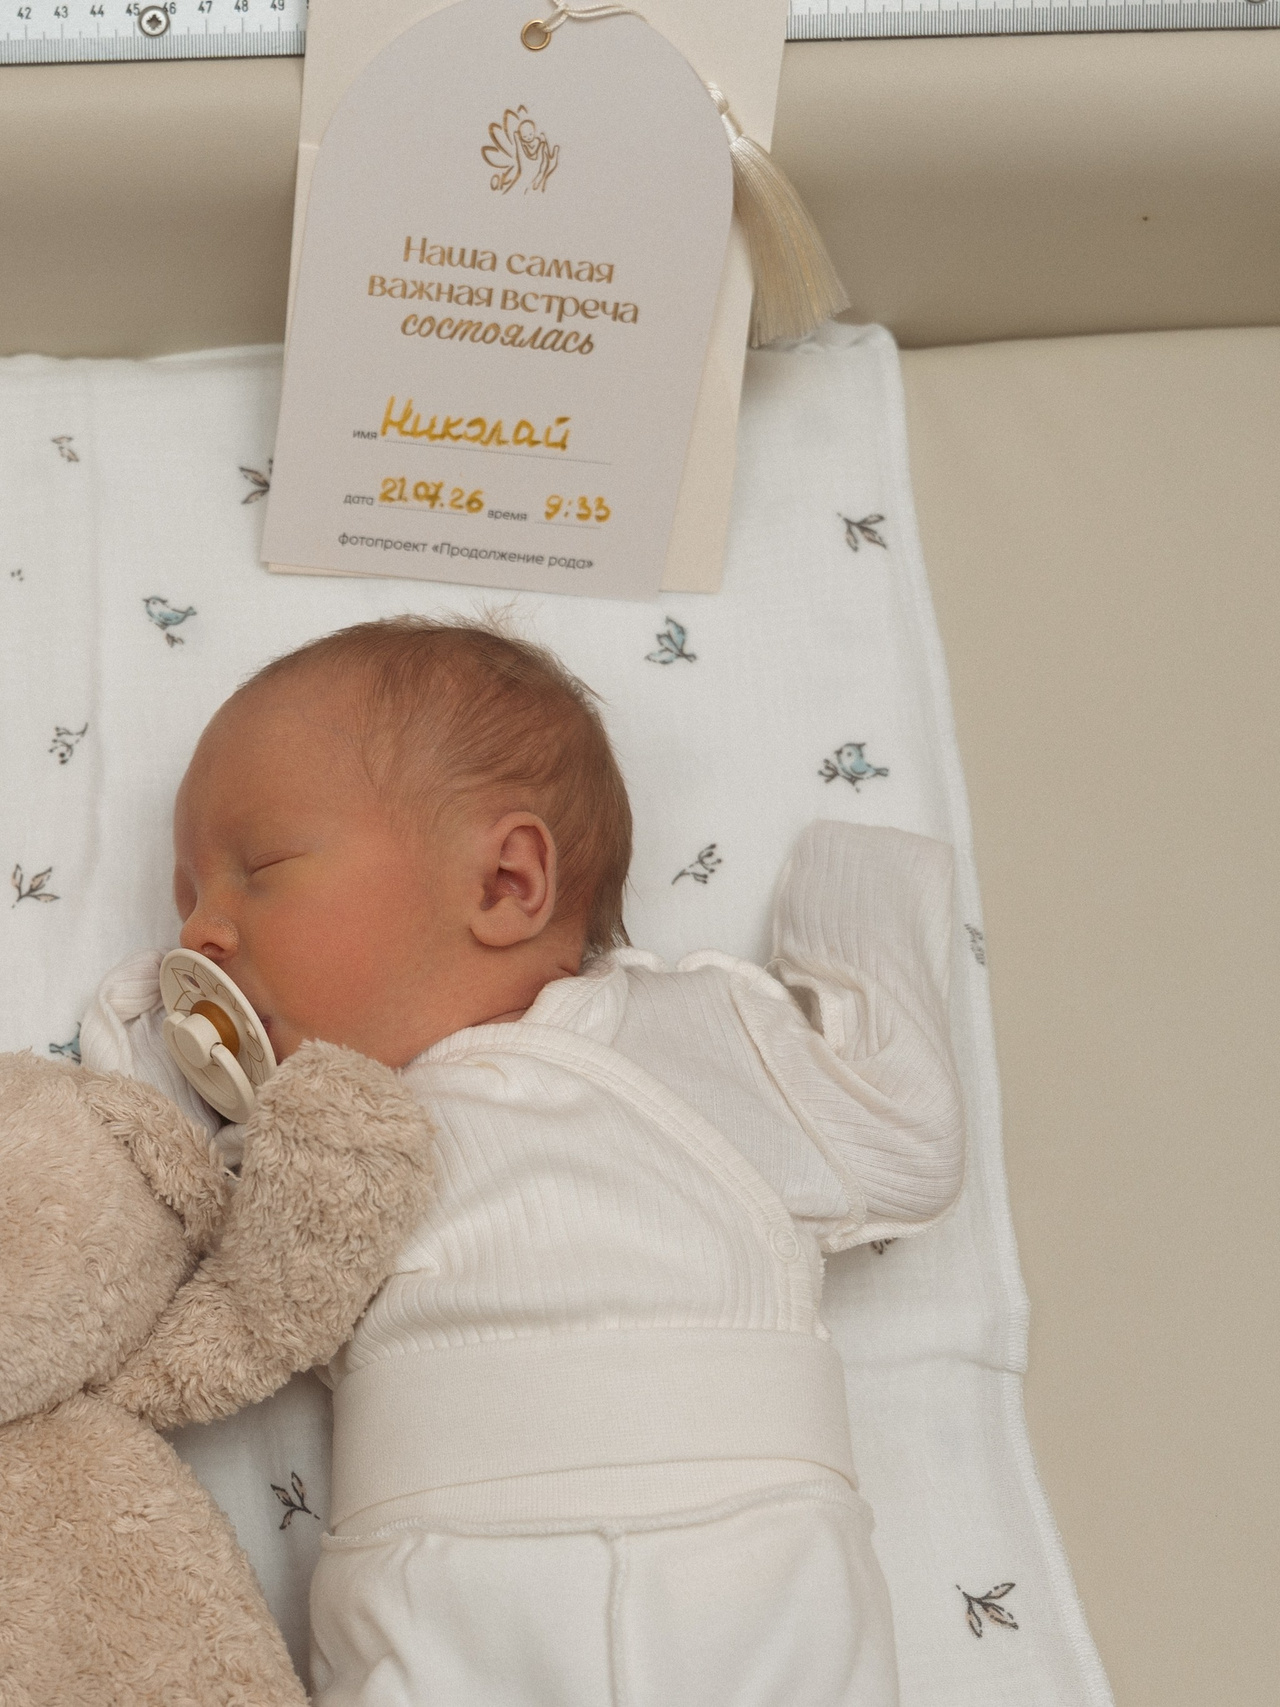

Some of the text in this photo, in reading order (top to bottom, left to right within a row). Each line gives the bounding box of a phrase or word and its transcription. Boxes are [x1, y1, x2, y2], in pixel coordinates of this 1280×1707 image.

[17, 7, 31, 19] 42
[54, 5, 68, 18] 43
[90, 5, 104, 16] 44
[126, 3, 140, 16] 45
[198, 0, 212, 13] 47
[234, 0, 248, 12] 48
[270, 0, 285, 11] 49
[403, 236, 615, 284] Наша самая
[367, 274, 638, 325] важная встреча
[400, 313, 595, 356] состоялась
[352, 429, 378, 441] имя
[380, 396, 571, 451] Николай
[342, 493, 374, 506] дата
[487, 509, 528, 522] время
[544, 494, 611, 522] 9:33
[338, 532, 594, 570] фотопроект «Продолжение рода»
